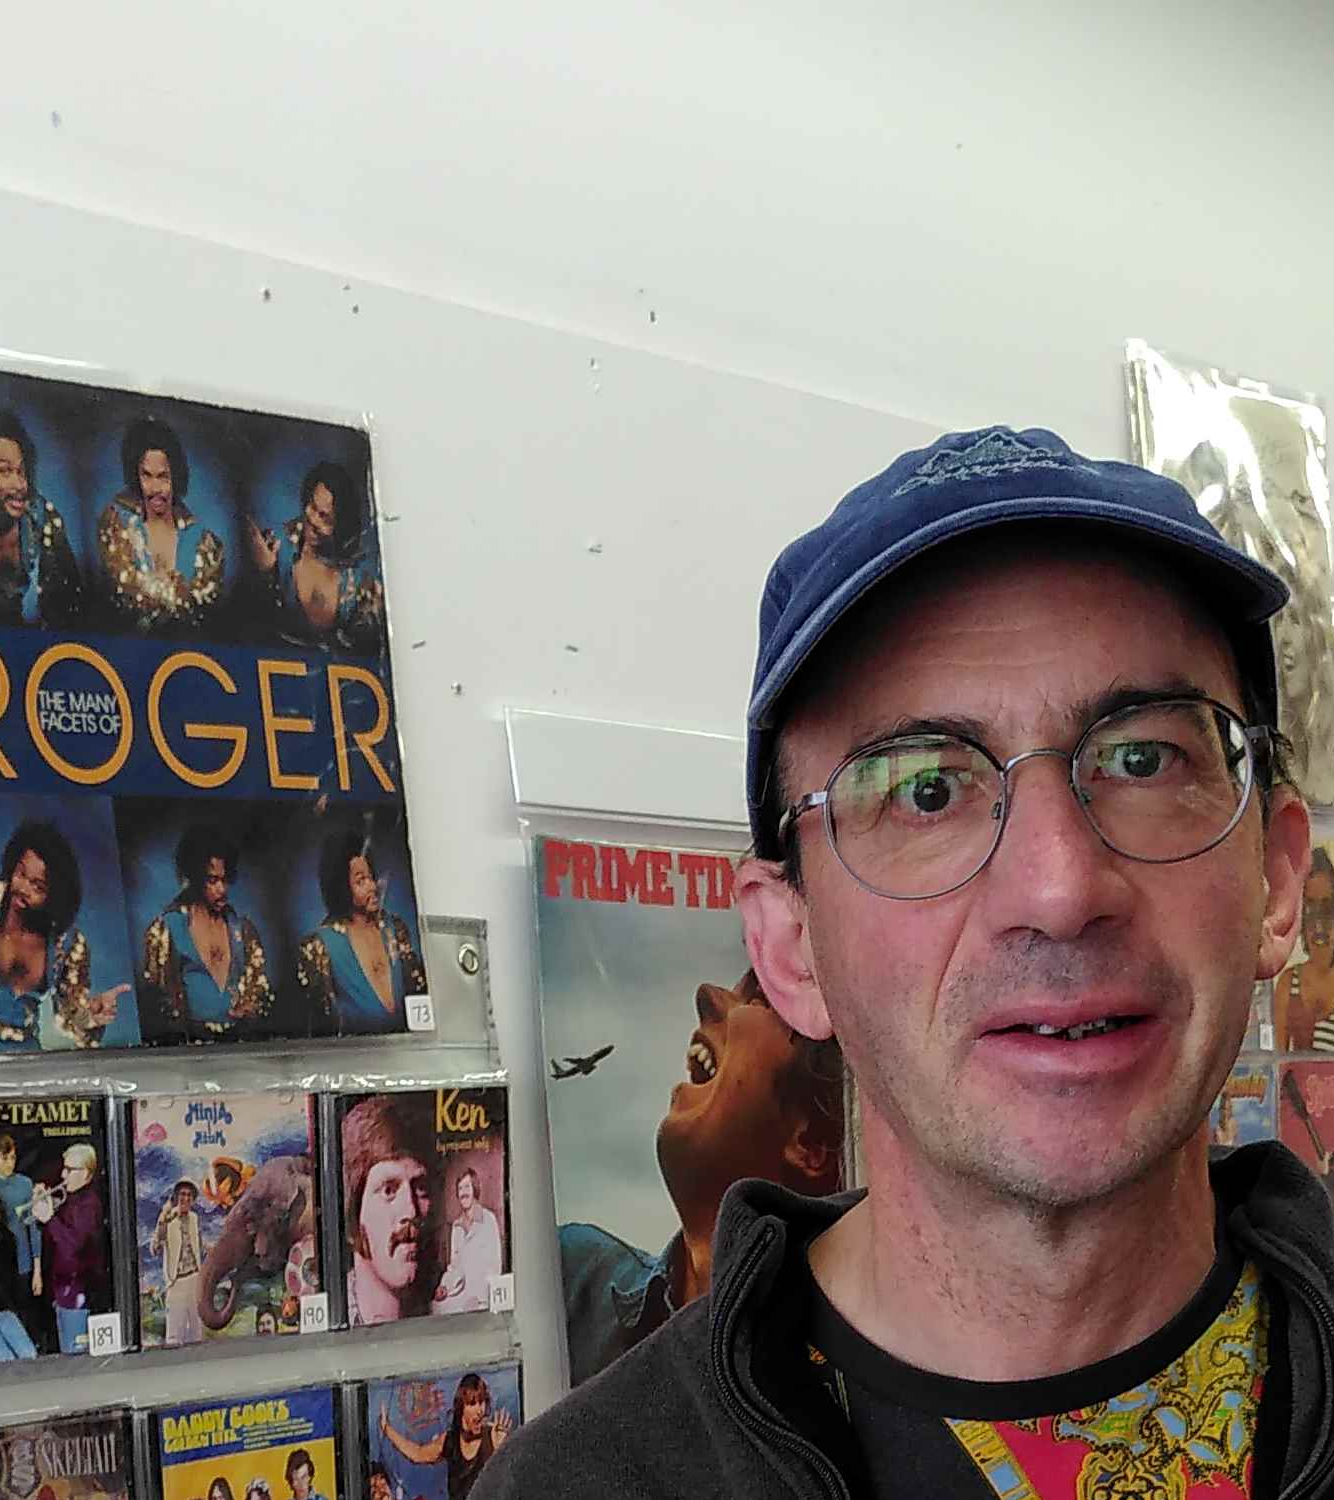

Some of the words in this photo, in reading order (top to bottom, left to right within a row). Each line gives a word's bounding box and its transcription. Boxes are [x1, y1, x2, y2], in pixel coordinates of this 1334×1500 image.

[39, 690, 66, 711] THE
[68, 692, 117, 714] MANY
[40, 711, 98, 733] FACETS
[99, 714, 121, 734] OF
[542, 839, 675, 908] PRIME
[411, 1005, 431, 1024] 73
[436, 1087, 491, 1133] Ken
[302, 1307, 325, 1324] 190
[92, 1325, 115, 1348] 189
